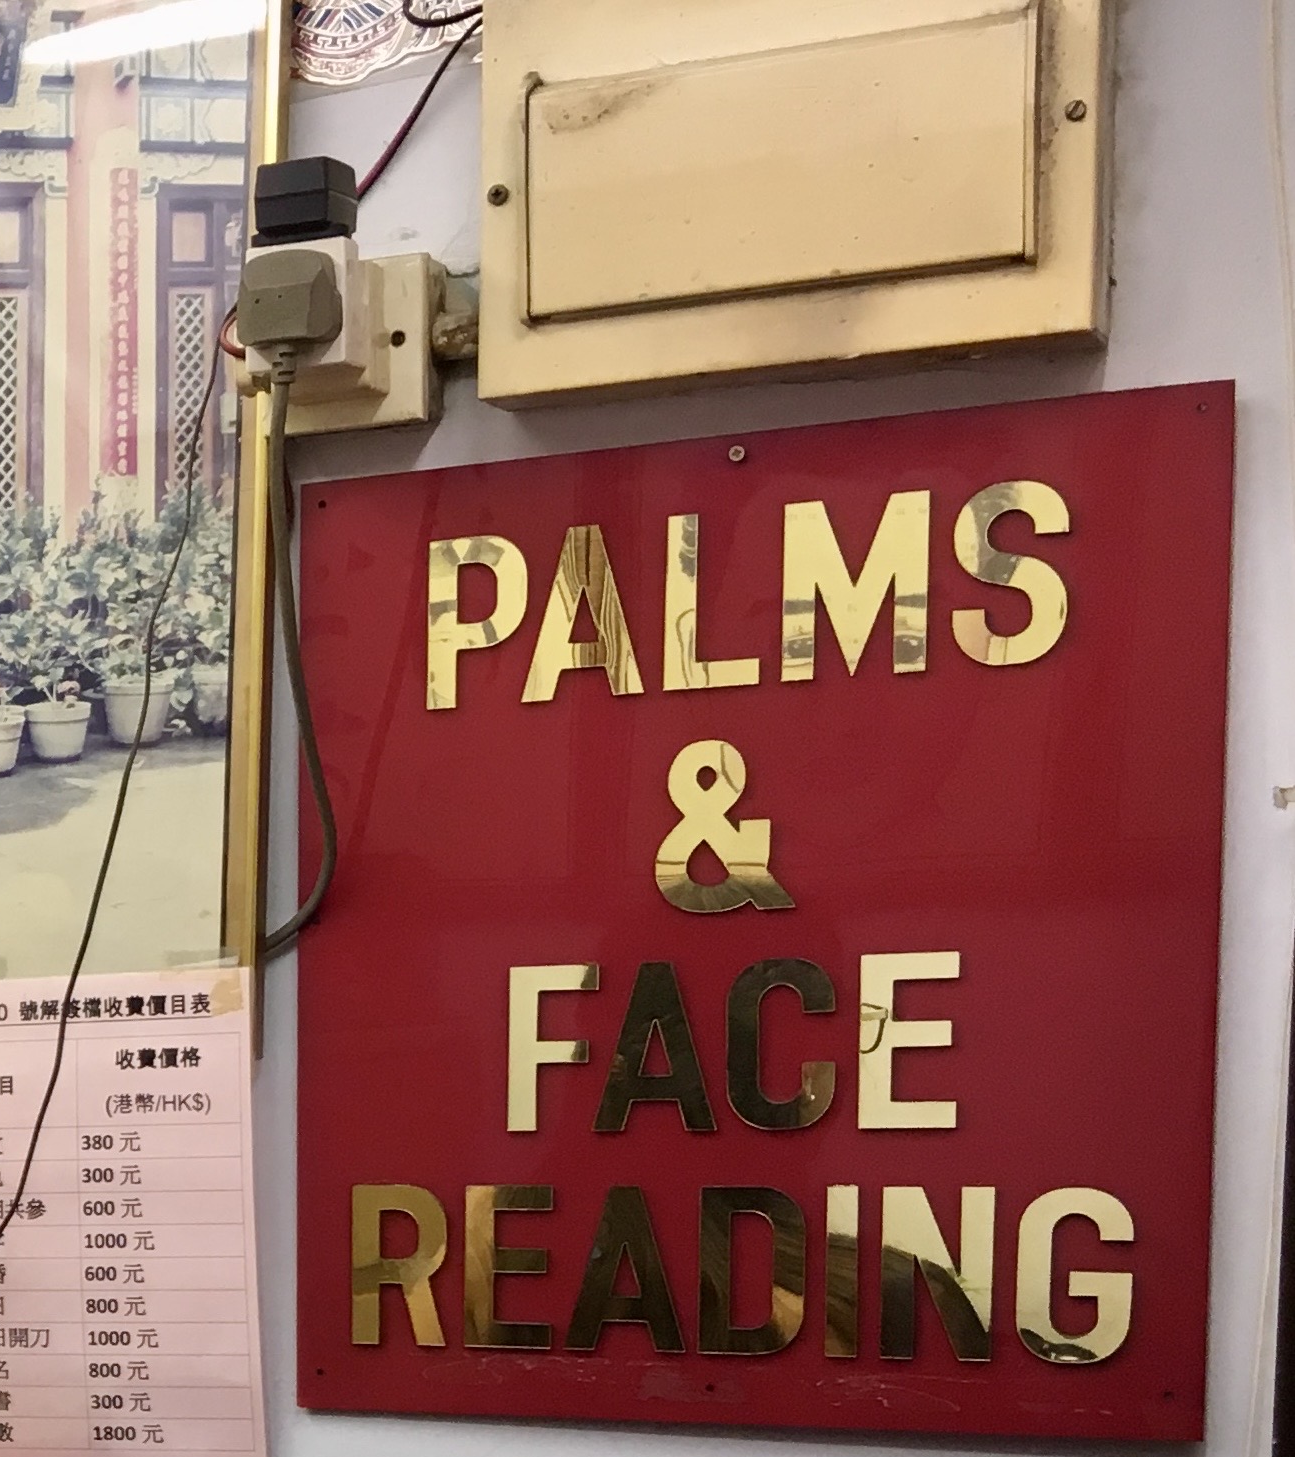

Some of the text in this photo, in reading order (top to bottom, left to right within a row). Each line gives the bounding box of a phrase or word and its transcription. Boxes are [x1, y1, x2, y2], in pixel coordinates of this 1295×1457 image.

[426, 480, 1071, 711] PALMS
[654, 738, 797, 914] &
[505, 950, 961, 1133] FACE
[115, 1046, 202, 1070] 收費價格
[105, 1093, 212, 1117] (港幣/HK$)
[81, 1135, 114, 1151] 380
[119, 1132, 141, 1152] 元
[82, 1168, 114, 1184] 300
[120, 1166, 142, 1186] 元
[83, 1200, 115, 1216] 600
[121, 1198, 143, 1218] 元
[84, 1233, 127, 1249] 1000
[133, 1231, 155, 1251] 元
[84, 1266, 117, 1282] 600
[123, 1264, 145, 1284] 元
[349, 1182, 1136, 1365] READING
[86, 1298, 119, 1314] 800
[124, 1296, 146, 1316] 元
[88, 1330, 131, 1346] 1000
[136, 1329, 159, 1349] 元
[89, 1362, 121, 1378] 800
[127, 1361, 149, 1381] 元
[91, 1394, 123, 1410] 300
[129, 1392, 151, 1412] 元
[93, 1426, 136, 1442] 1800
[142, 1424, 164, 1444] 元
